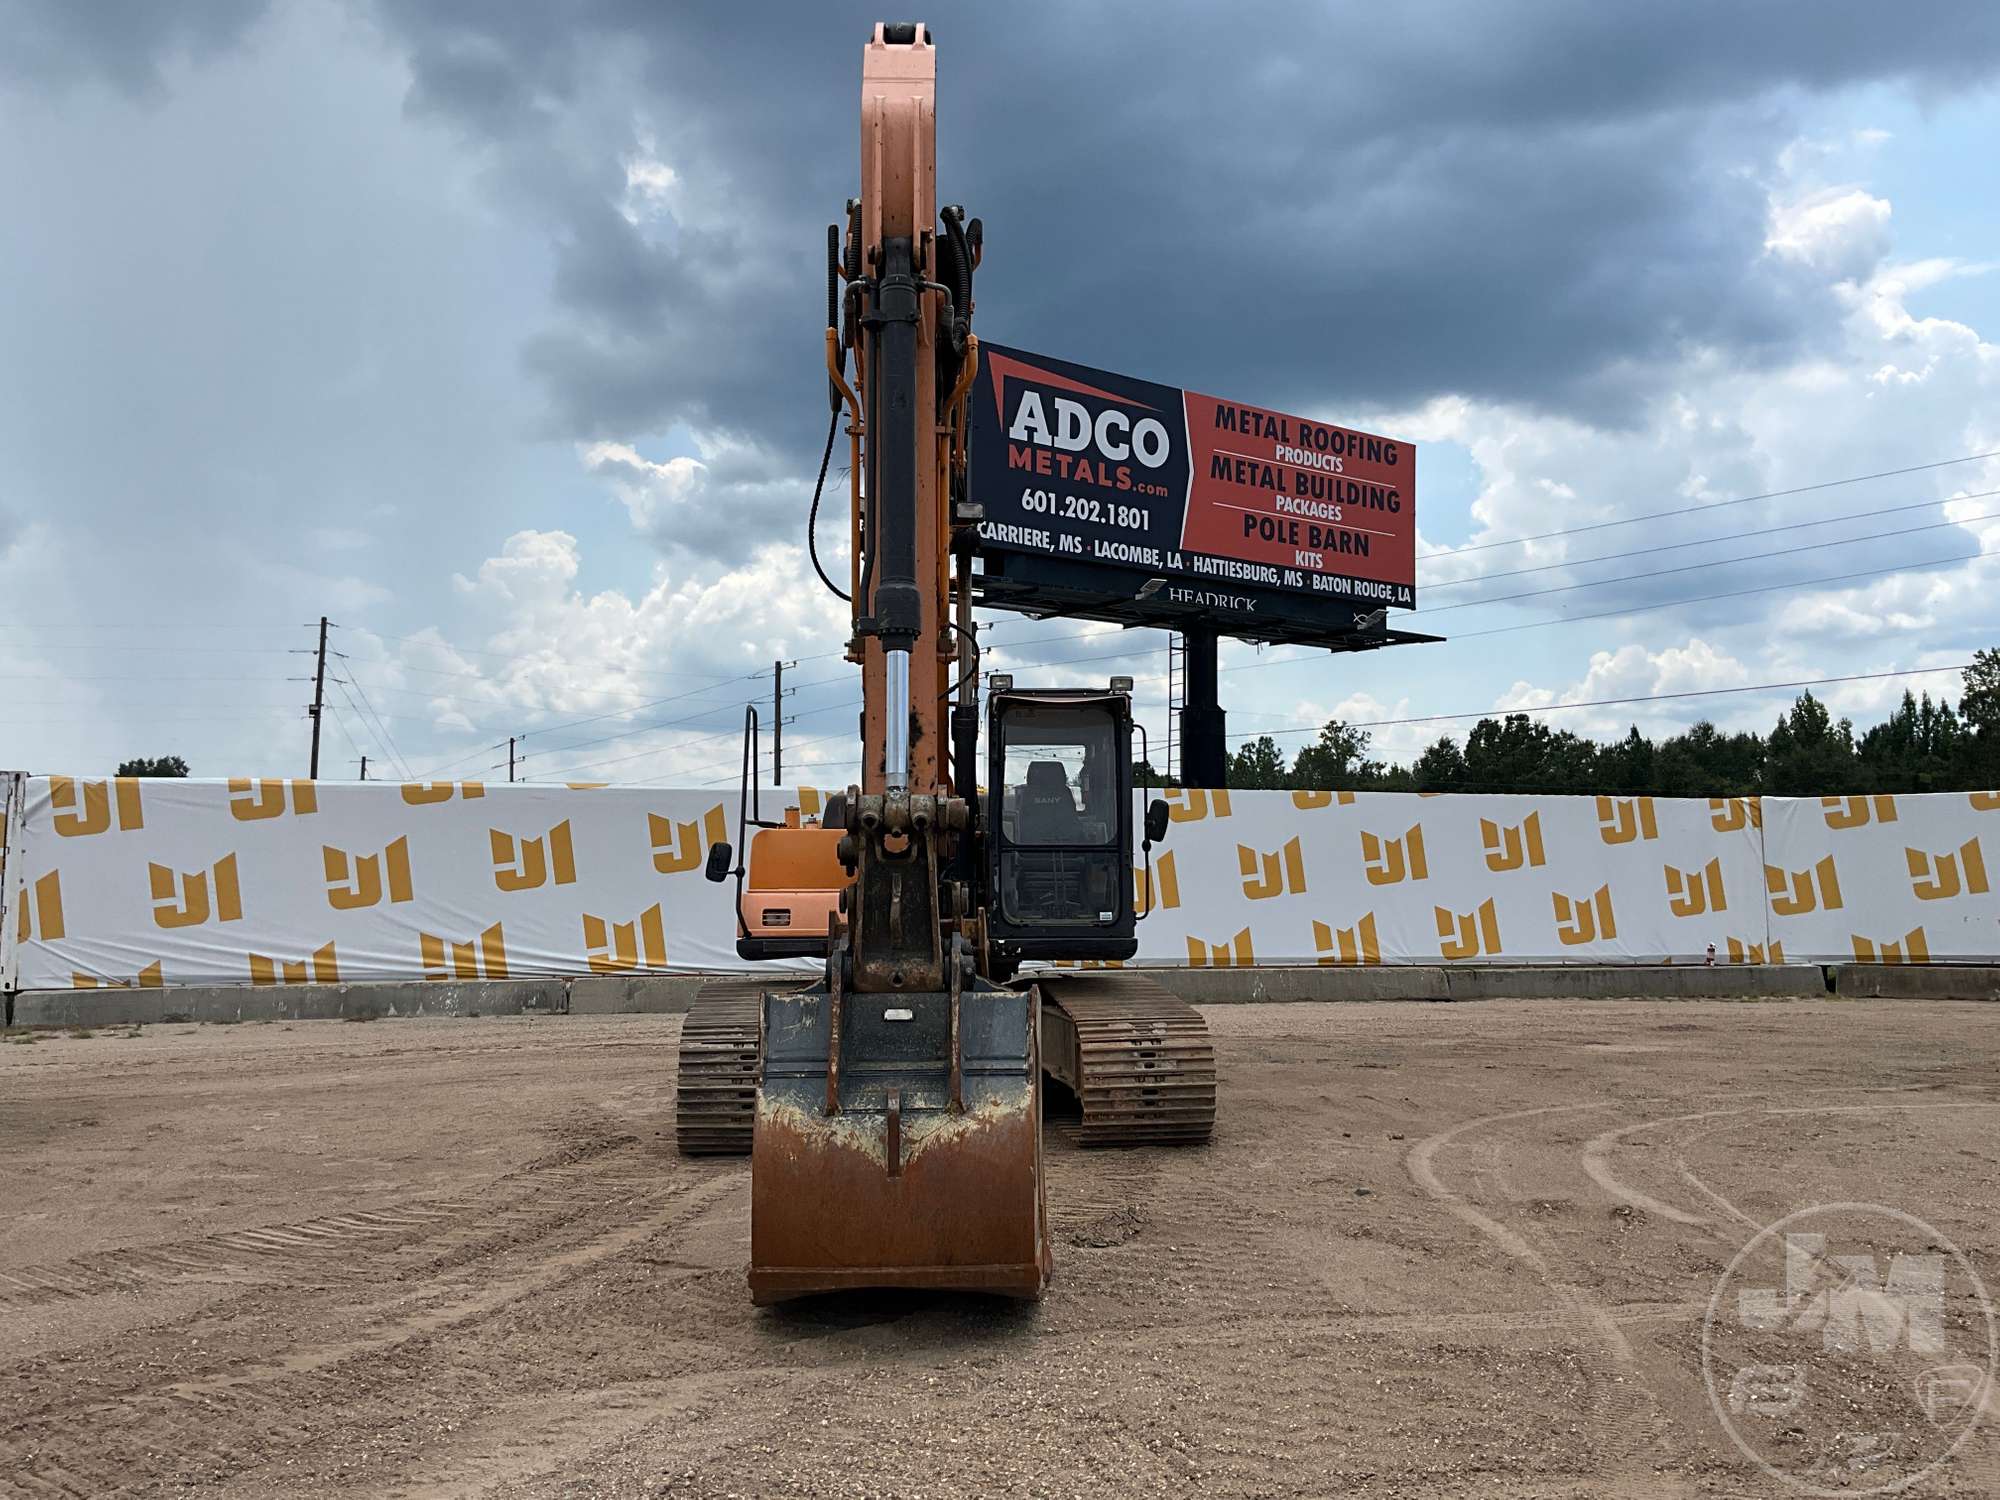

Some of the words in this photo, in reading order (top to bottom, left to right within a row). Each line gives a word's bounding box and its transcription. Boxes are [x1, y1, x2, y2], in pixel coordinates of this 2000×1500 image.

[1009, 390, 1170, 469] ADCO
[1215, 404, 1290, 443] METAL
[1300, 423, 1399, 466] ROOFING
[1009, 444, 1168, 497] METALS.com
[1275, 444, 1344, 473] PRODUCTS
[1210, 455, 1287, 493] METAL
[1295, 471, 1401, 514] BUILDING
[1021, 488, 1150, 531] 601.202.1801
[1275, 495, 1343, 521] PACKAGES
[1244, 513, 1300, 546] POLE
[1308, 524, 1370, 557] BARN
[976, 520, 1055, 552] CARRIERE,
[1058, 533, 1083, 554] MS
[1094, 539, 1164, 569] LACOMBE,
[1167, 551, 1183, 570] LA
[1193, 555, 1280, 587] HATTIESBURG,
[1284, 569, 1303, 588] MS
[1312, 573, 1351, 595] BATON
[1354, 582, 1396, 603] ROUGE,
[1398, 586, 1412, 603] LA
[1295, 550, 1324, 569] KITS
[1168, 587, 1257, 612] HEADRICK
